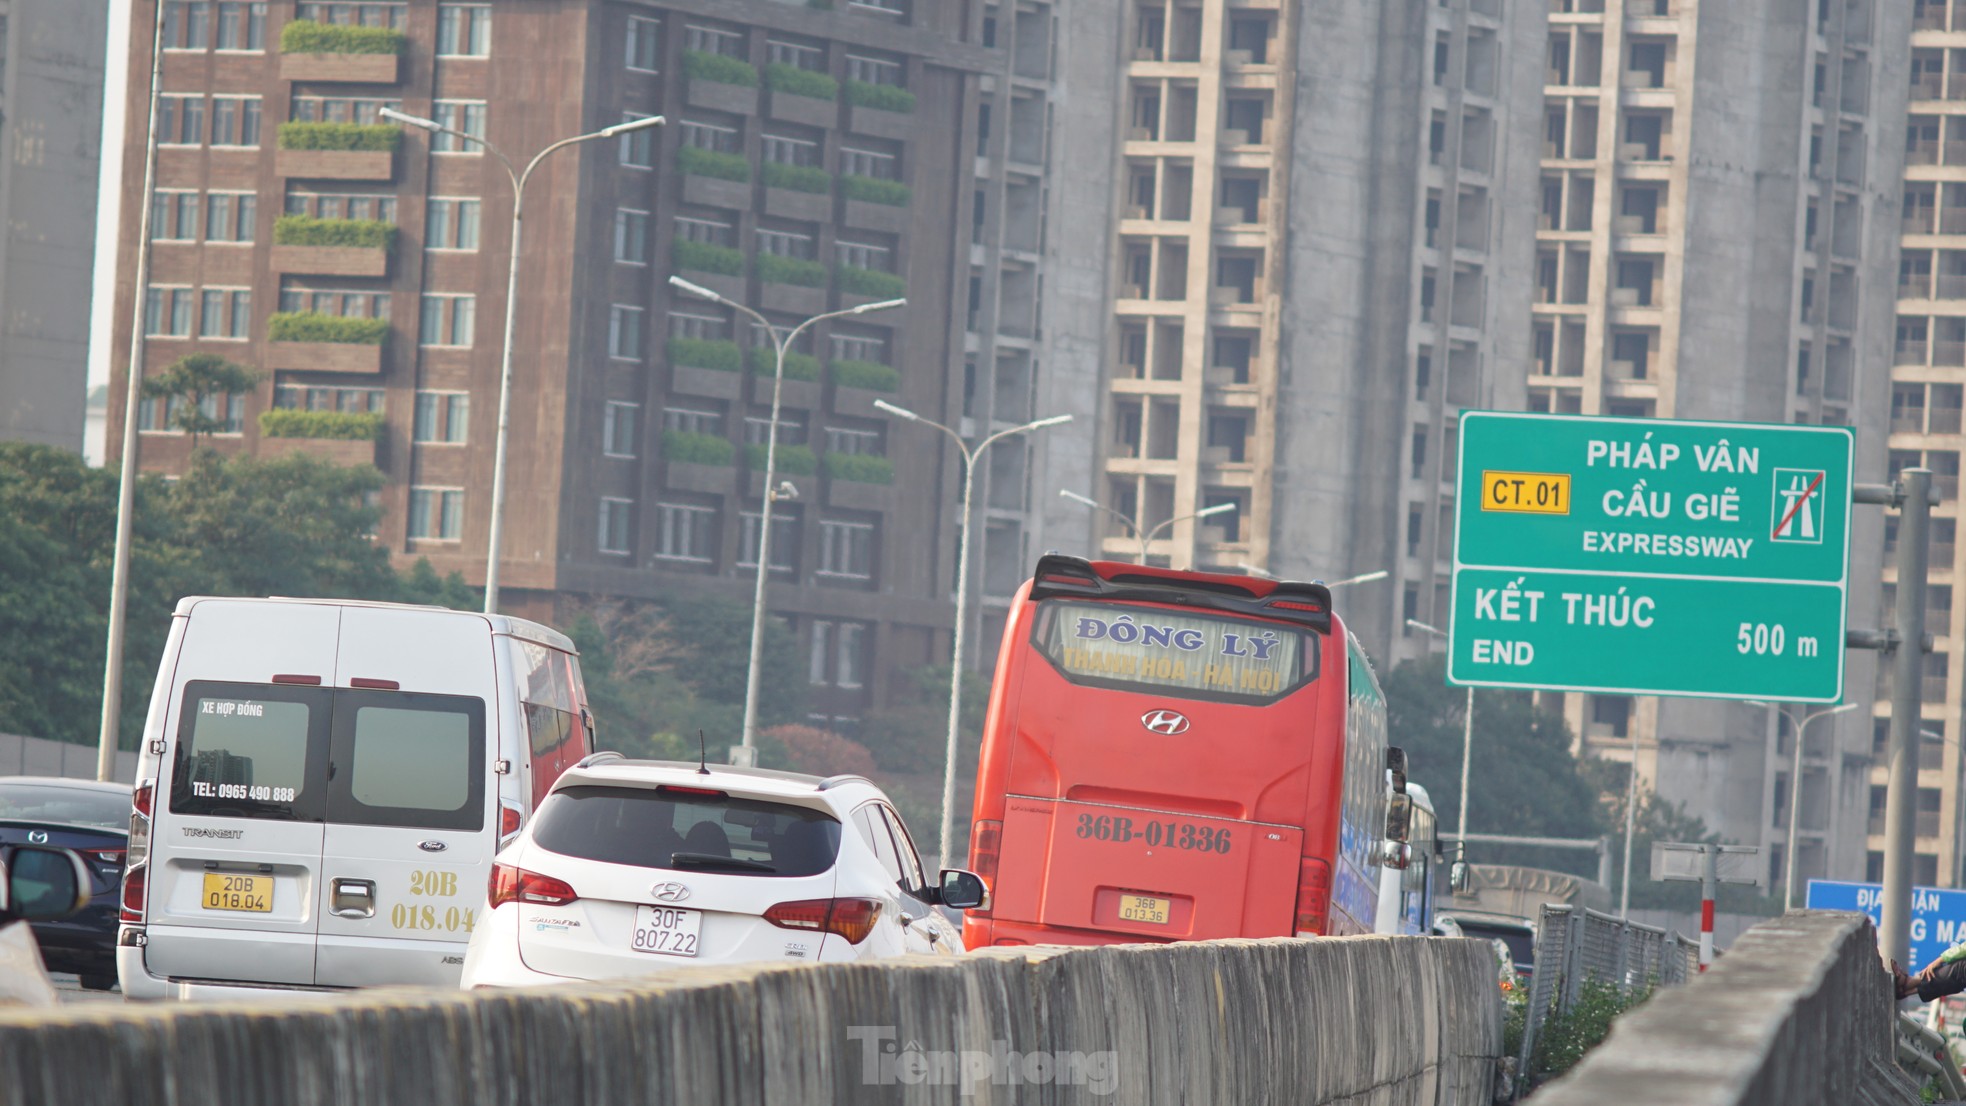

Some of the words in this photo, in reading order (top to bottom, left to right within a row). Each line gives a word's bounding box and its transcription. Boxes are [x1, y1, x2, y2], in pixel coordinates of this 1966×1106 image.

[1587, 432, 1680, 470] PHÁP
[1694, 439, 1760, 474] VÂN
[1492, 480, 1561, 507] CT.01
[1602, 478, 1671, 518] CẦU
[1685, 487, 1740, 522] GIẼ
[1583, 531, 1753, 559] EXPRESSWAY
[1475, 577, 1545, 622] KẾT
[1562, 586, 1655, 628] THÚC
[1075, 614, 1204, 651] ĐÔNG
[1221, 631, 1279, 660] LÝ
[1737, 622, 1785, 656] 500
[1798, 635, 1818, 657] m
[1472, 639, 1534, 665] END
[1064, 647, 1137, 675] THANH
[1240, 666, 1280, 696] NỘI
[202, 701, 214, 714] XE
[216, 701, 235, 718] HỢP
[193, 781, 216, 797] TEL:
[218, 783, 247, 799] 0965
[249, 785, 270, 801] 490
[273, 786, 295, 802] 888
[182, 826, 244, 839] TRANSIT
[1076, 812, 1232, 855] 36B-01336
[223, 876, 254, 892] 20B
[410, 869, 458, 897] 20B
[210, 892, 264, 910] 018.04
[1134, 897, 1156, 909] 36B
[651, 908, 687, 930] 30F
[1124, 907, 1163, 922] 013.36
[634, 928, 697, 954] 807.22
